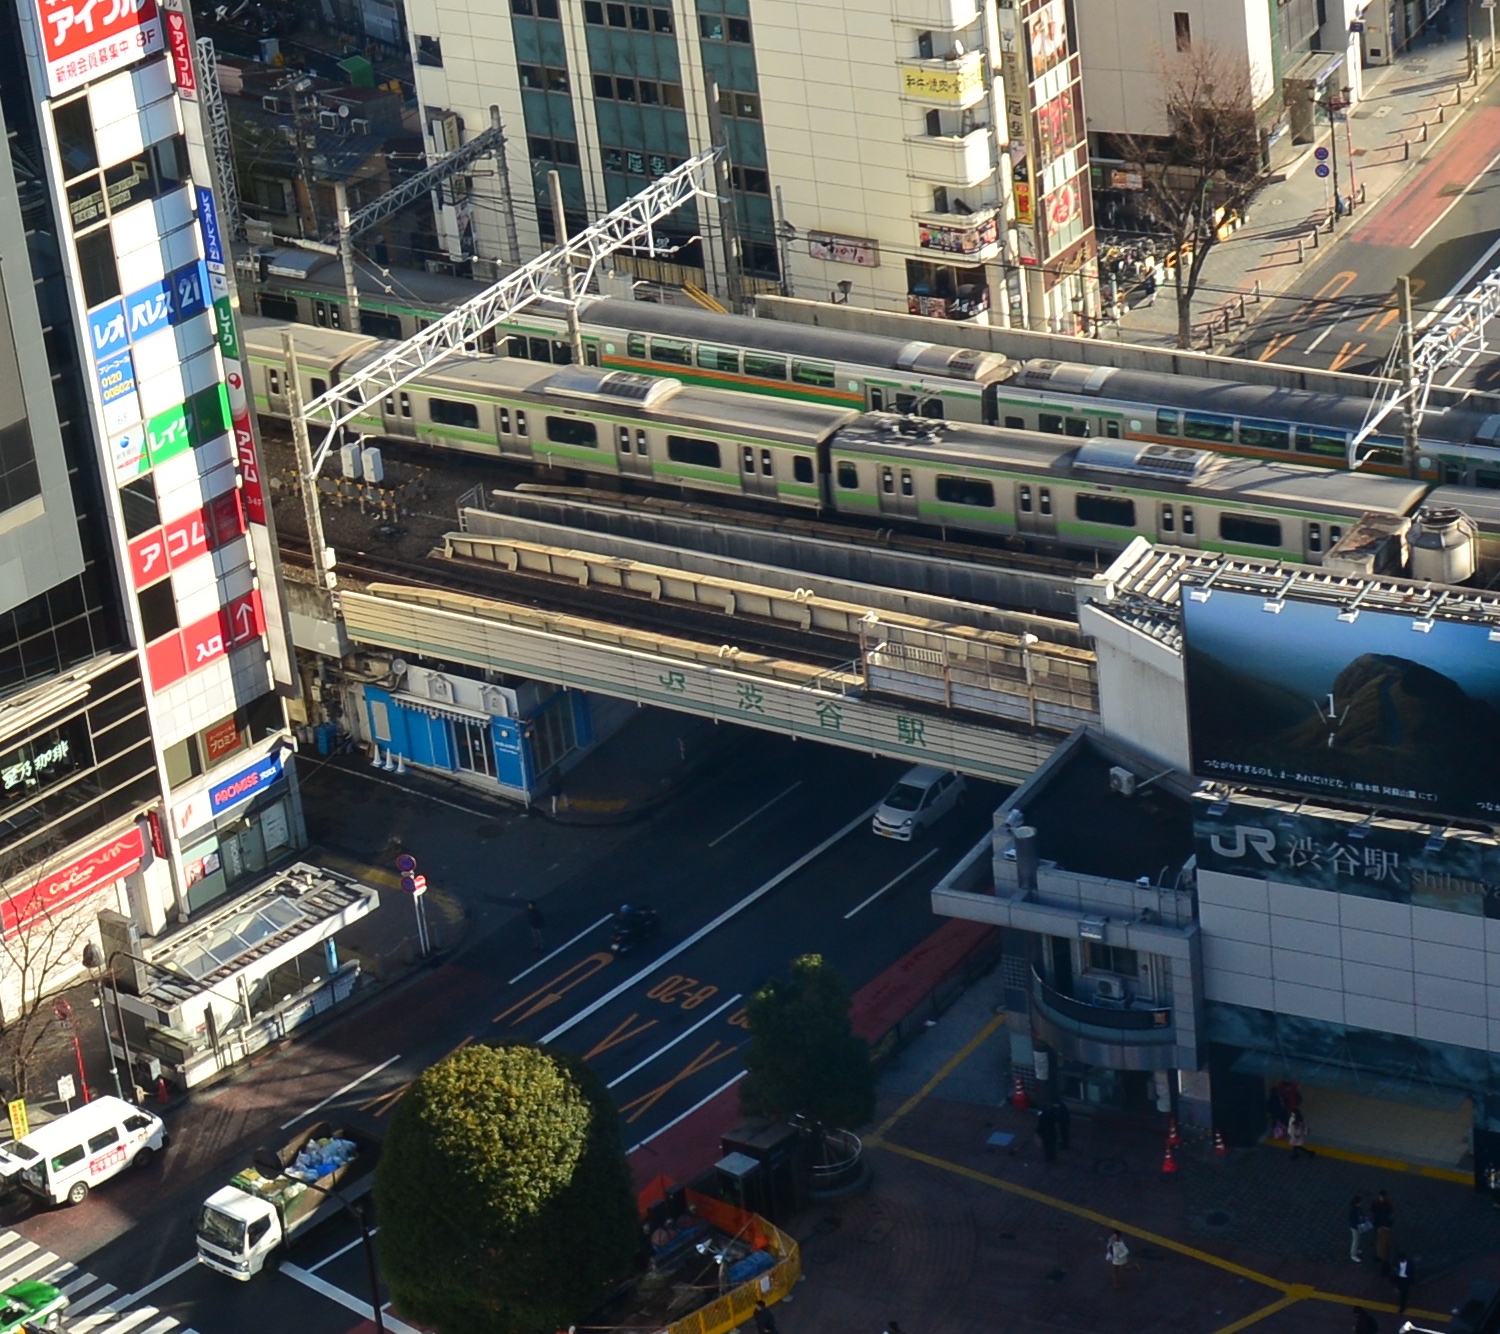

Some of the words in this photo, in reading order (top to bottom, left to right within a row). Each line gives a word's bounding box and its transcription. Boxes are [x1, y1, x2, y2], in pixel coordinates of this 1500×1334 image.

[55, 40, 129, 84] 新規会員募集中
[136, 29, 156, 48] 8F
[172, 29, 193, 88] アイフル
[201, 190, 221, 262] レオパレス21
[94, 276, 201, 351] レオパレス21
[219, 307, 234, 346] レイク
[102, 370, 122, 388] 0120
[151, 414, 193, 453] レイク
[237, 430, 258, 484] アコム
[139, 520, 211, 573] アコム
[196, 638, 222, 663] 入口
[659, 670, 687, 692] JR
[210, 730, 239, 753] プロミス
[213, 771, 259, 806] PROMISE
[1211, 824, 1278, 866] JR
[1287, 836, 1401, 884] 渋谷駅
